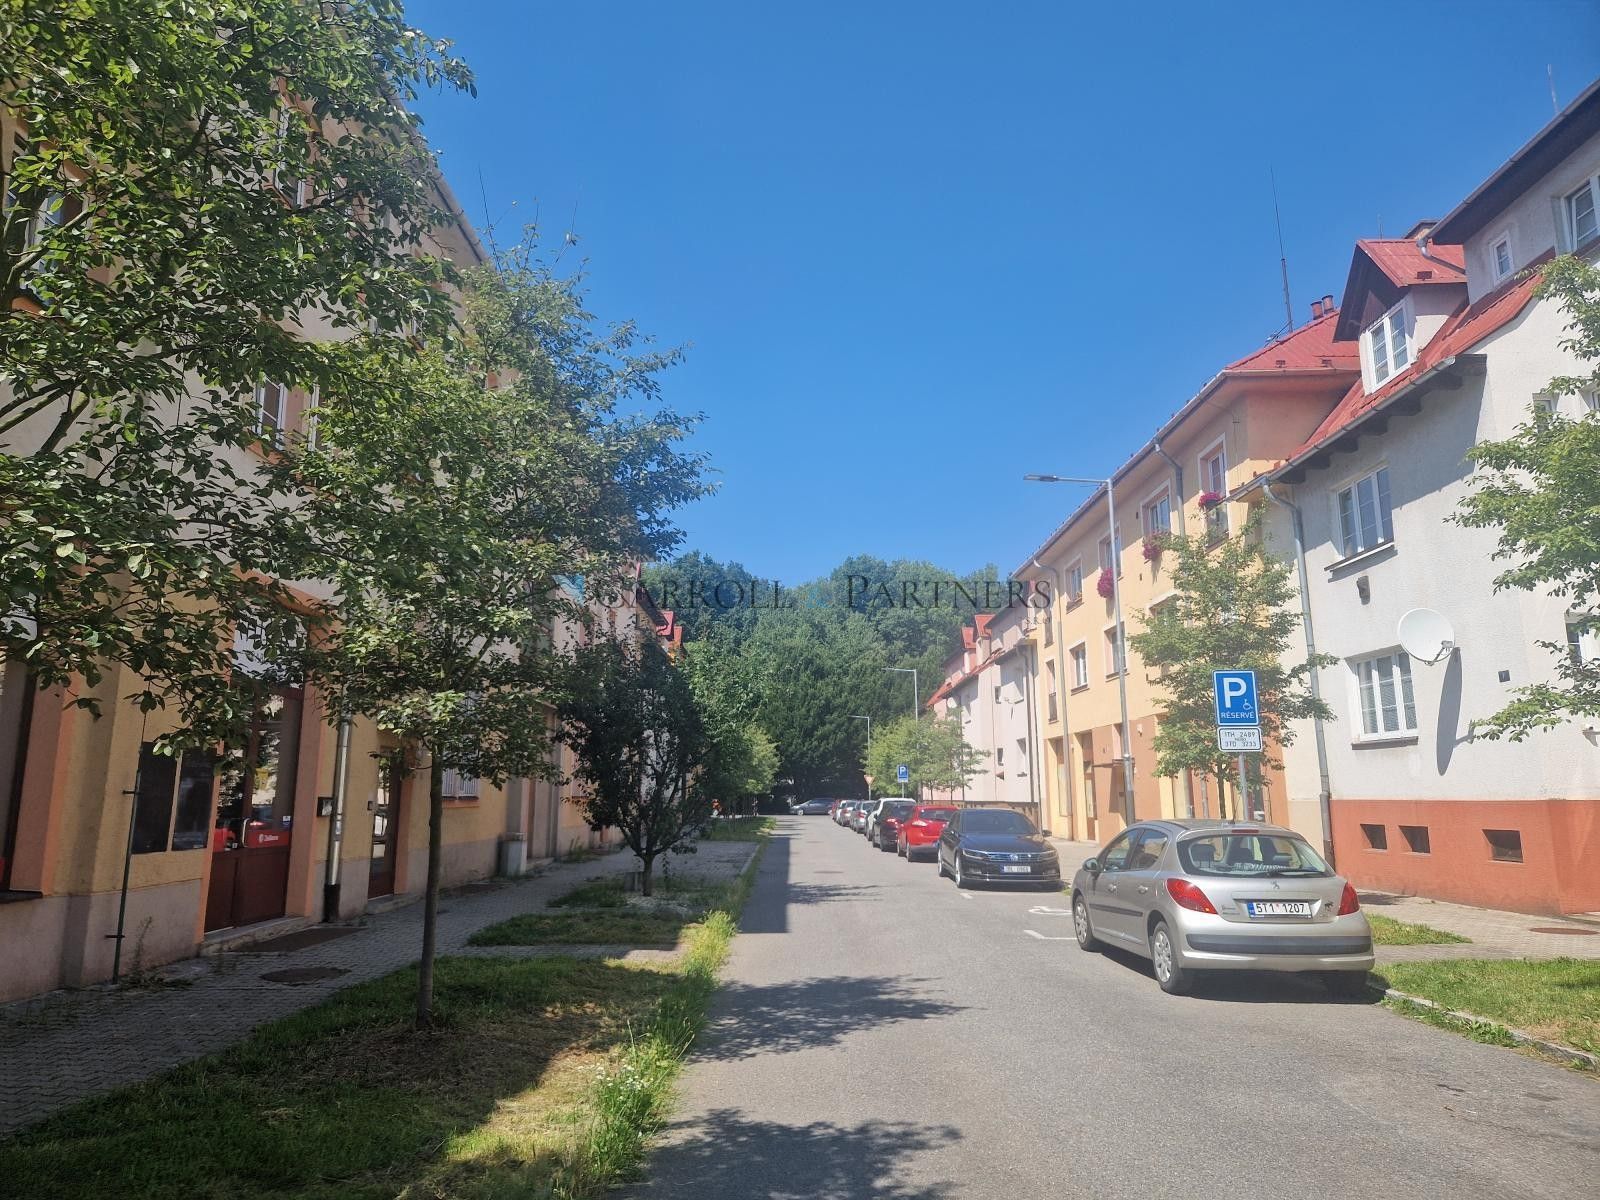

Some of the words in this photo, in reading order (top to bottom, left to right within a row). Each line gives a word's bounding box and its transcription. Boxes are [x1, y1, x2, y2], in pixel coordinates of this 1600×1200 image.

[1222, 677, 1247, 709] P
[899, 766, 906, 775] P
[1256, 903, 1275, 913] 5T1
[1282, 903, 1305, 913] 1207
